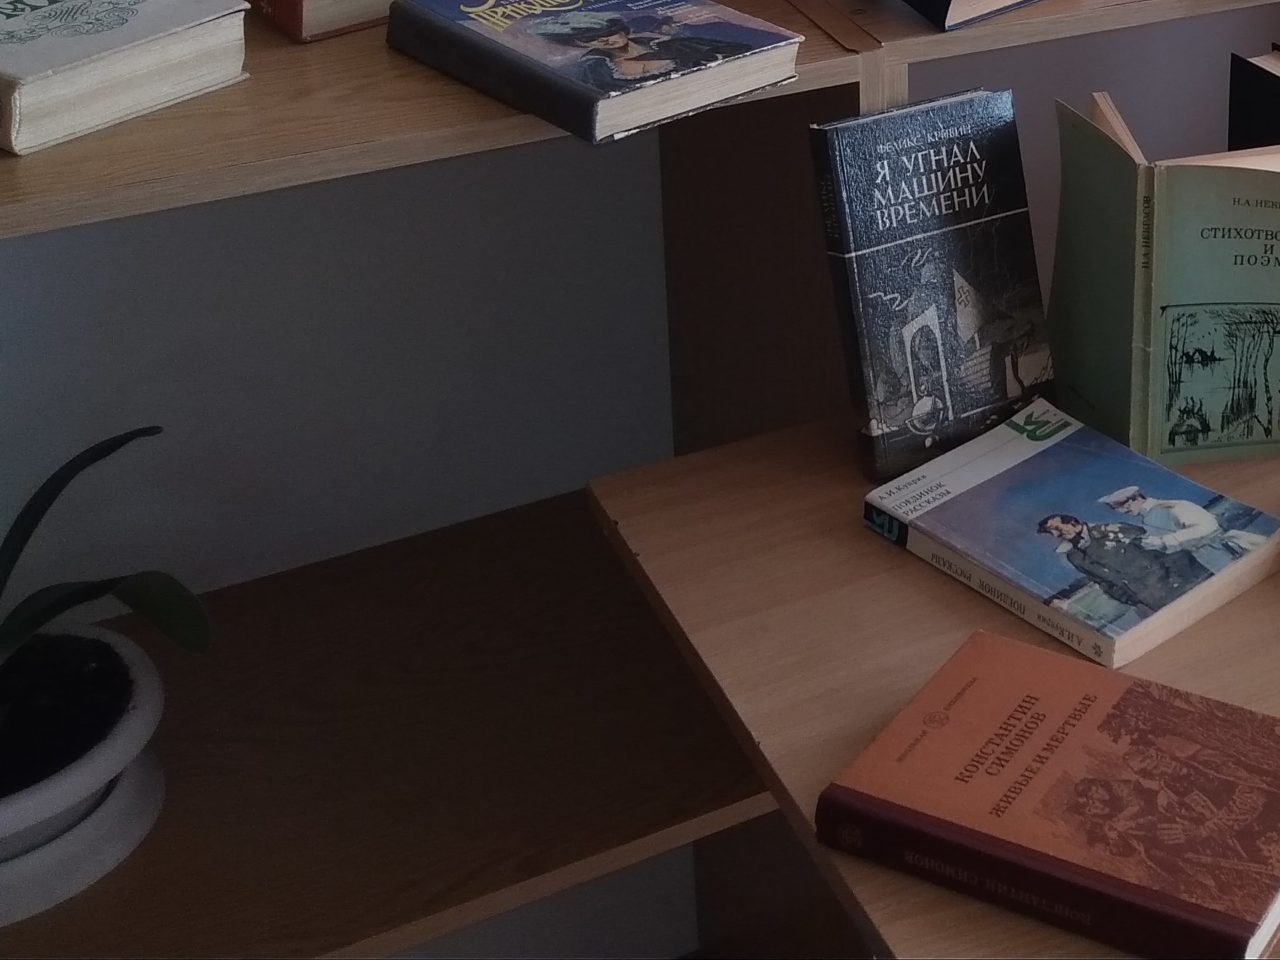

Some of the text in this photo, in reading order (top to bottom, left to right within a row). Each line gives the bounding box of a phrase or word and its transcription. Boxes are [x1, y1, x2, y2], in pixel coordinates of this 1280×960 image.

[875, 139, 981, 183] Я УГНАЛ
[872, 161, 987, 209] МАШИНУ
[876, 183, 990, 230] ВРЕМЕНИ
[1263, 243, 1274, 255] И
[891, 482, 947, 512] ПОЕДИНОК
[903, 489, 953, 517] РАССКАЗЫ
[929, 553, 973, 582] РАССКАЗЫ
[978, 581, 1026, 616] ПОЕДИНОК
[954, 694, 1040, 784] КОНСТАНТИН
[985, 710, 1047, 778] СИМОНОВ
[989, 761, 1037, 818] ЖИВЫЕ
[1044, 694, 1098, 752] МЕРТВЫЕ
